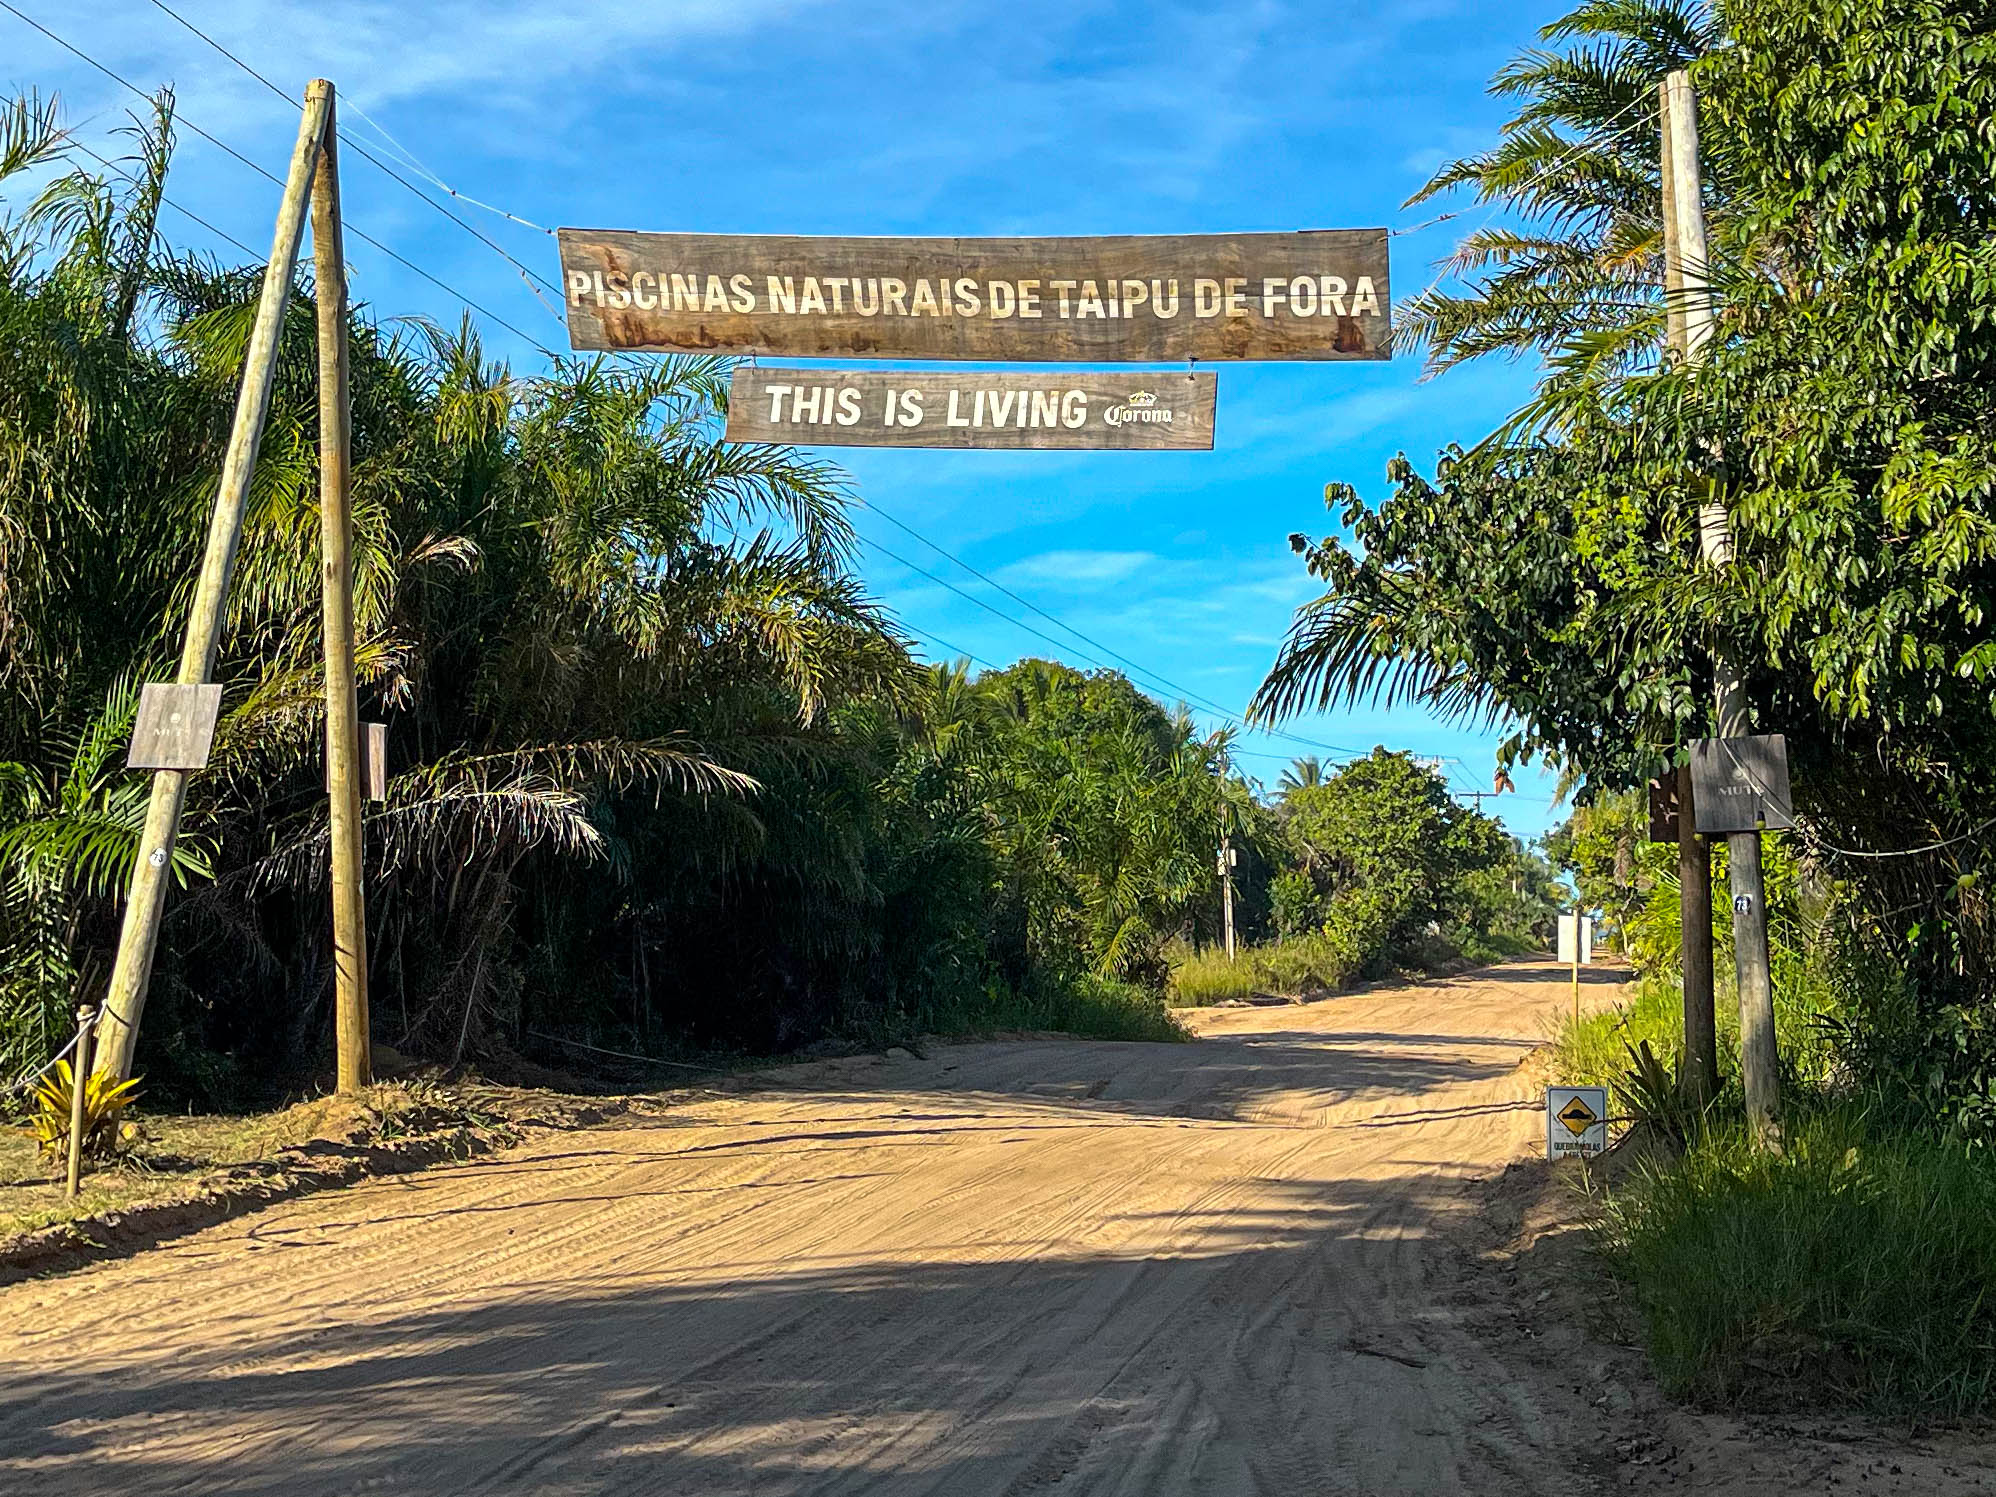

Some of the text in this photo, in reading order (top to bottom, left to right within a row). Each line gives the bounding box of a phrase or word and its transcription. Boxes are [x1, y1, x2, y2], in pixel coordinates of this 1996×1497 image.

[566, 269, 1381, 318] PISCINAS NATURAIS DE TAIPU DE FORA
[765, 385, 1088, 428] THIS IS LIVING
[1103, 403, 1174, 427] Corona
[1736, 900, 1748, 911] 73
